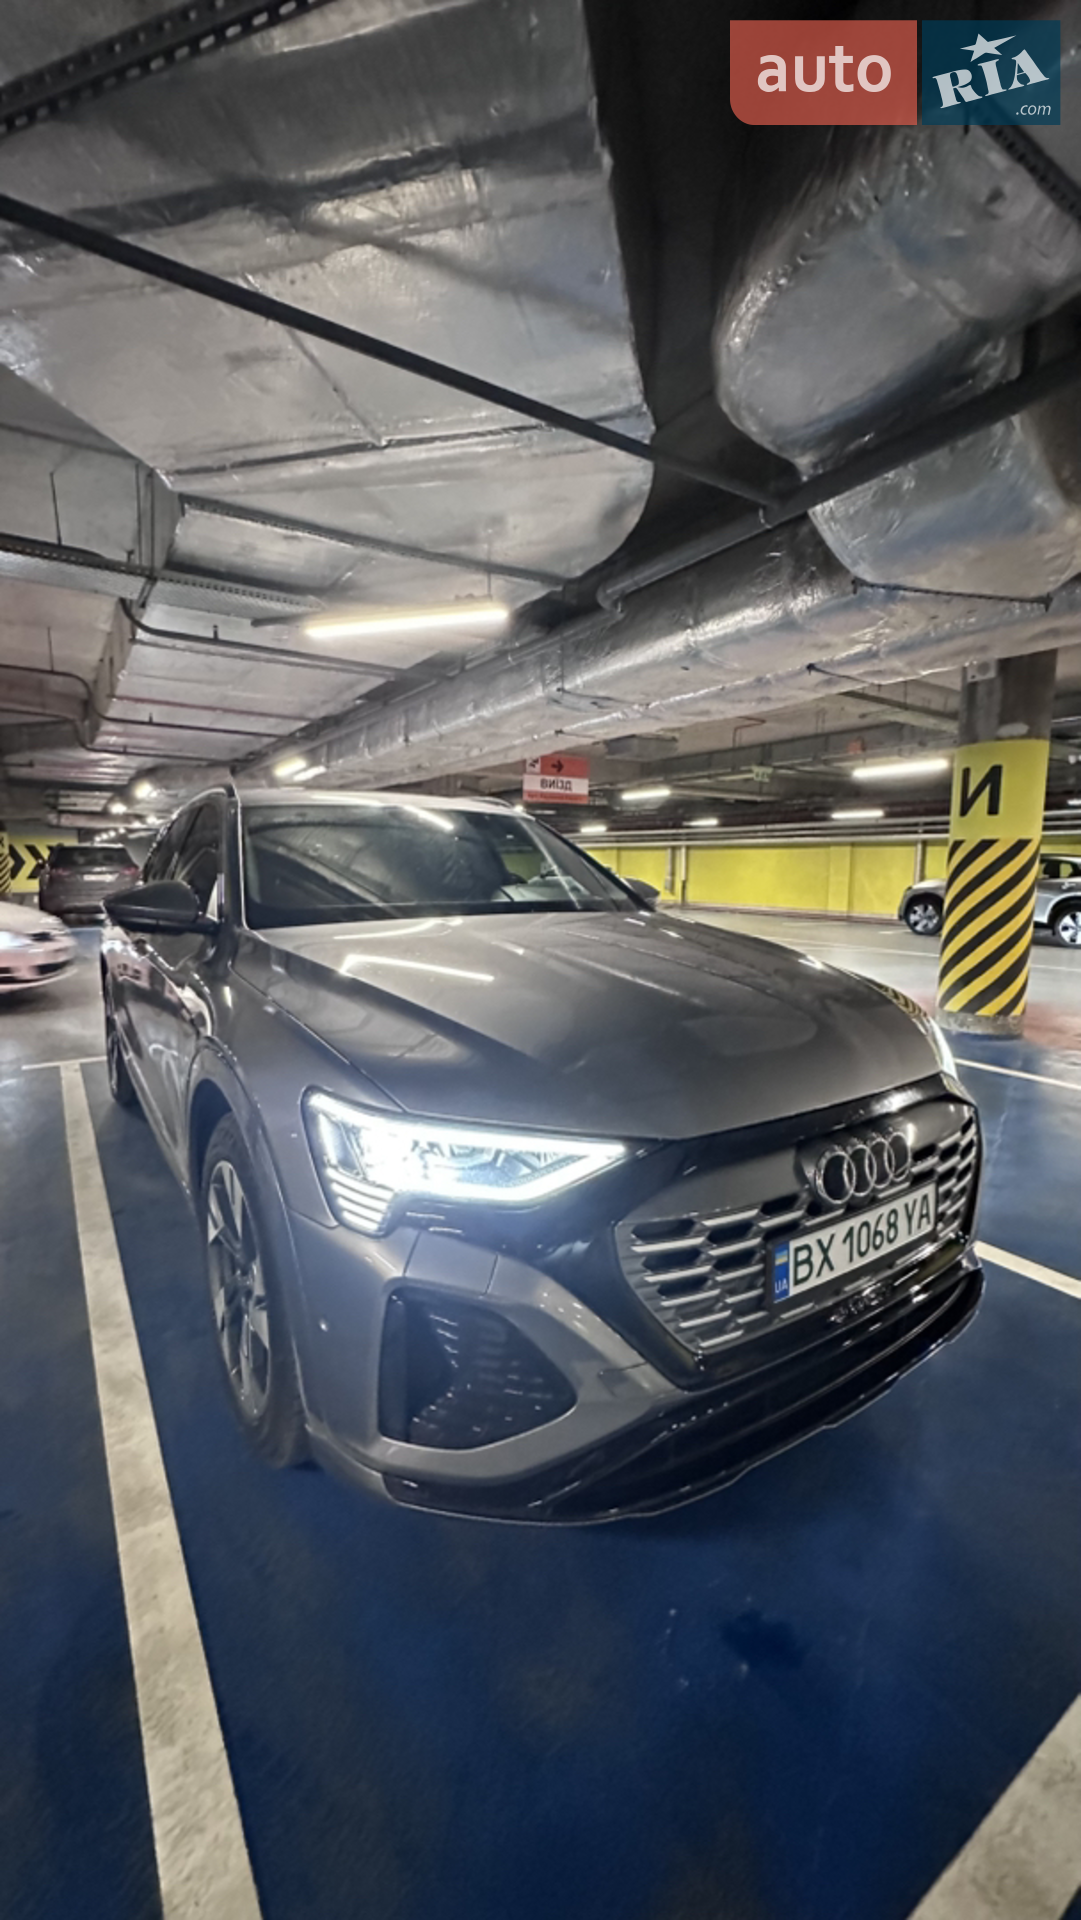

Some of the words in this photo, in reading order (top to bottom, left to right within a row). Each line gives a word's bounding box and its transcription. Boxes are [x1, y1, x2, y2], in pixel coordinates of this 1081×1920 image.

[959, 764, 1003, 817] И
[793, 1233, 836, 1287] BX
[842, 1208, 899, 1264] 1068
[904, 1193, 931, 1235] YA
[774, 1278, 788, 1293] UA
